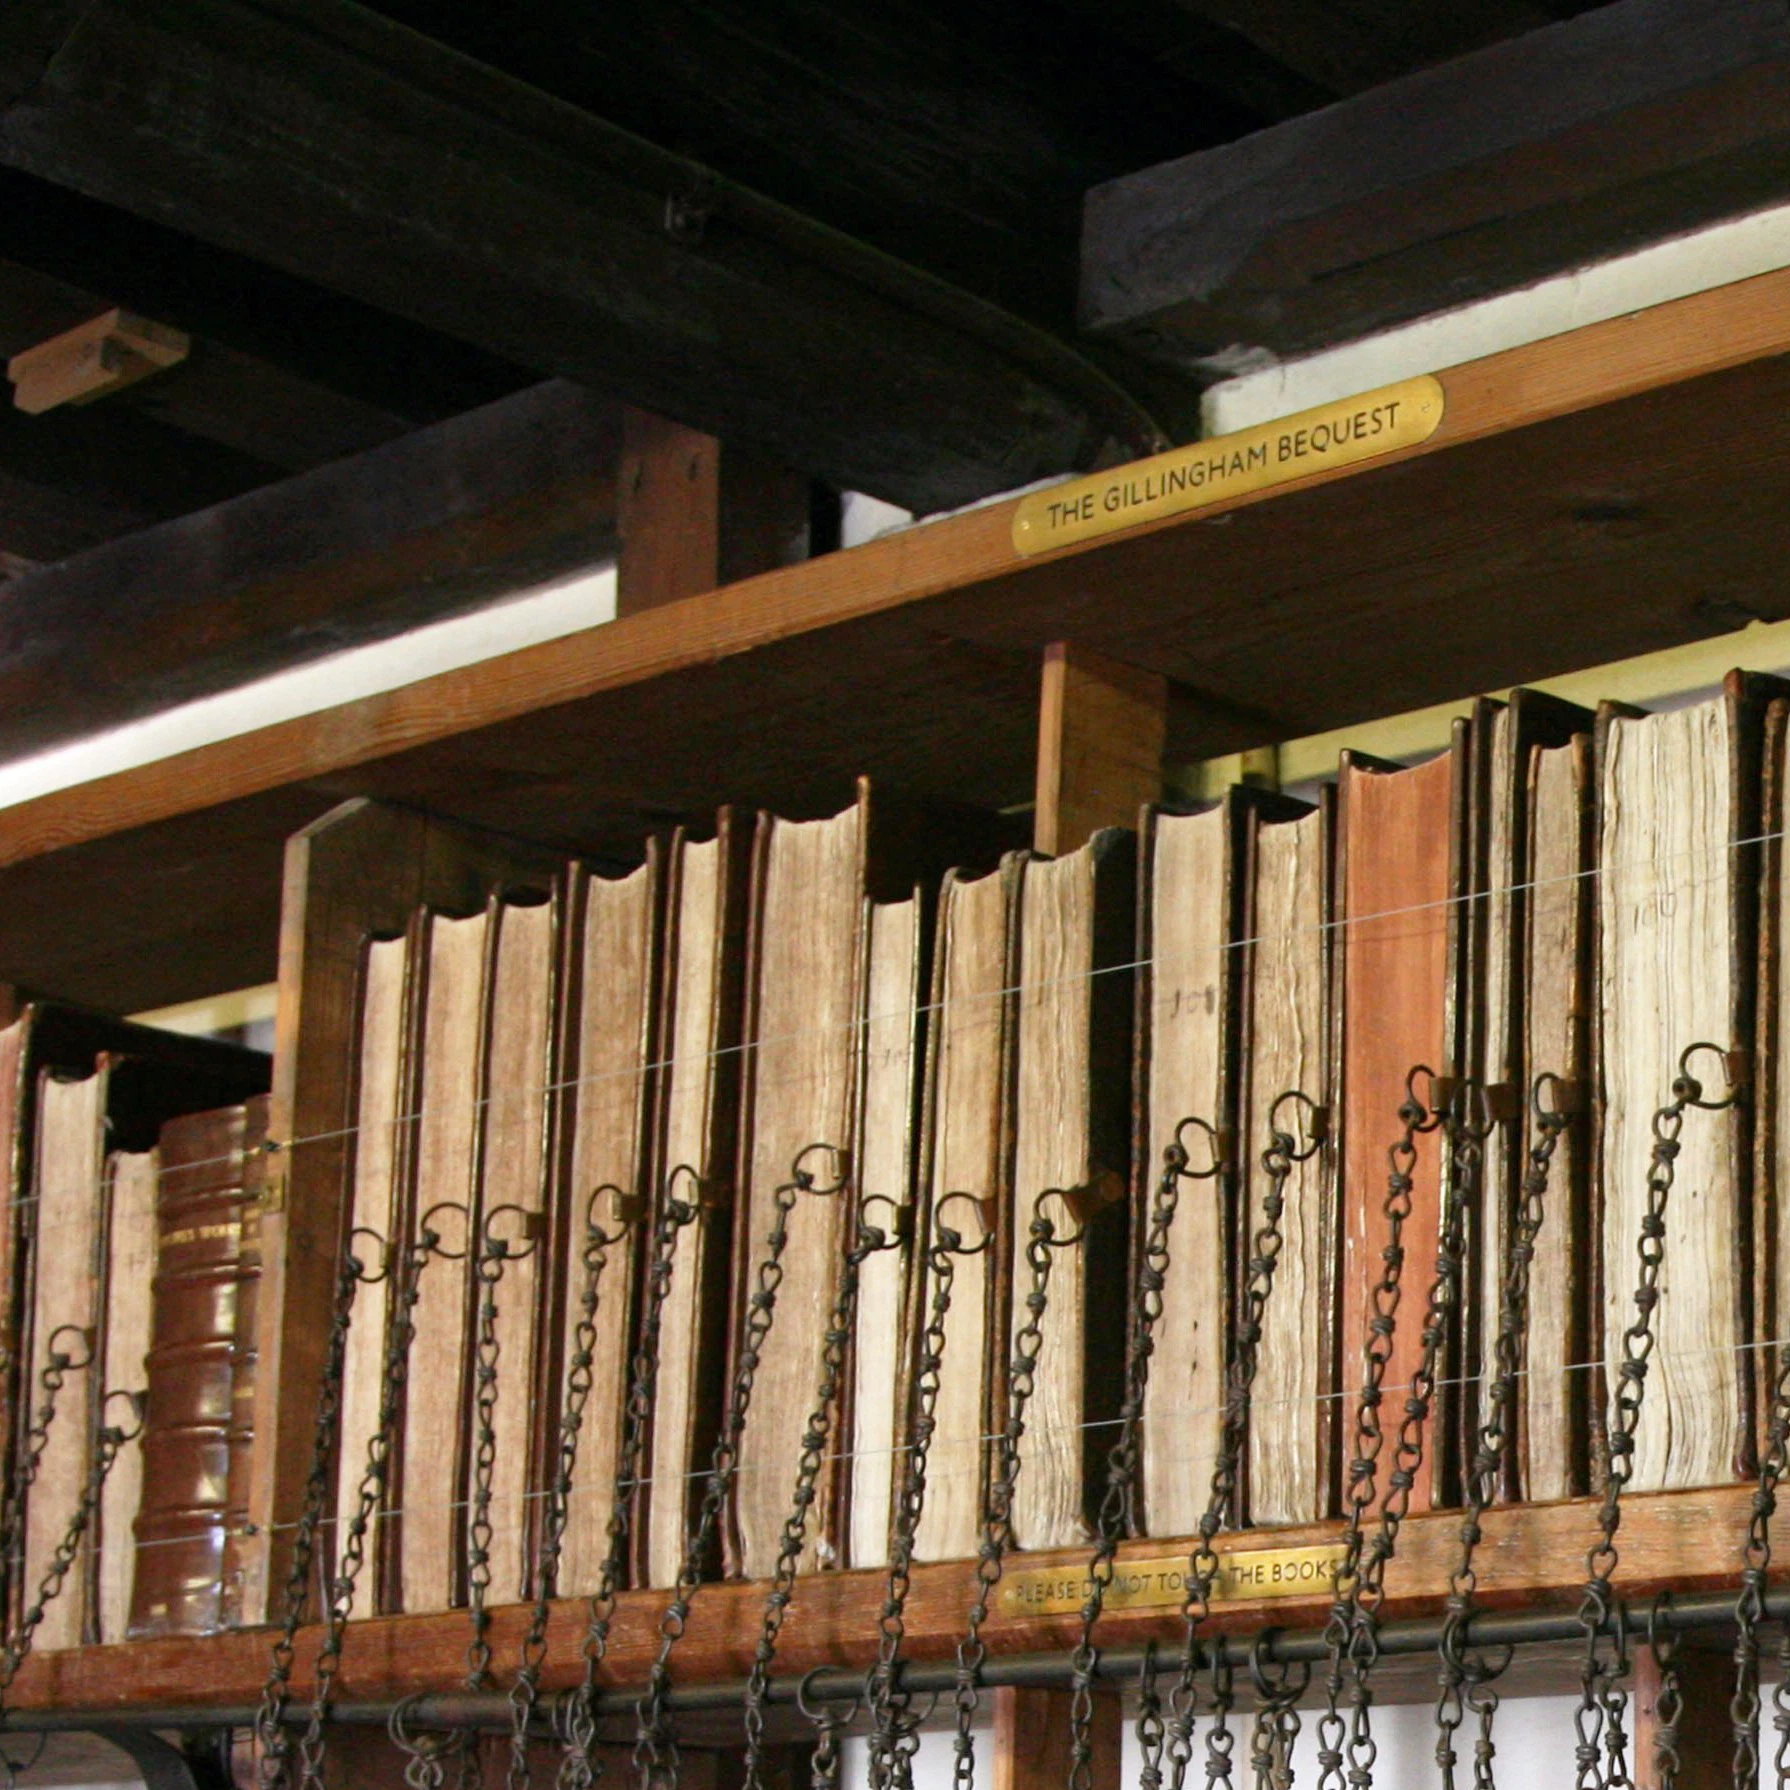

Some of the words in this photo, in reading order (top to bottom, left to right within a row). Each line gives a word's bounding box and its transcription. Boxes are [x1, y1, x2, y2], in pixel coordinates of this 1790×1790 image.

[1048, 495, 1094, 529] THE
[1104, 441, 1268, 512] GILLINGHAM
[1278, 402, 1400, 462] BEQUEST
[1016, 1581, 1075, 1605] PLEASE
[1114, 1573, 1150, 1595] NOT
[1230, 1566, 1264, 1585] THE
[1271, 1559, 1338, 1582] BOOKS
